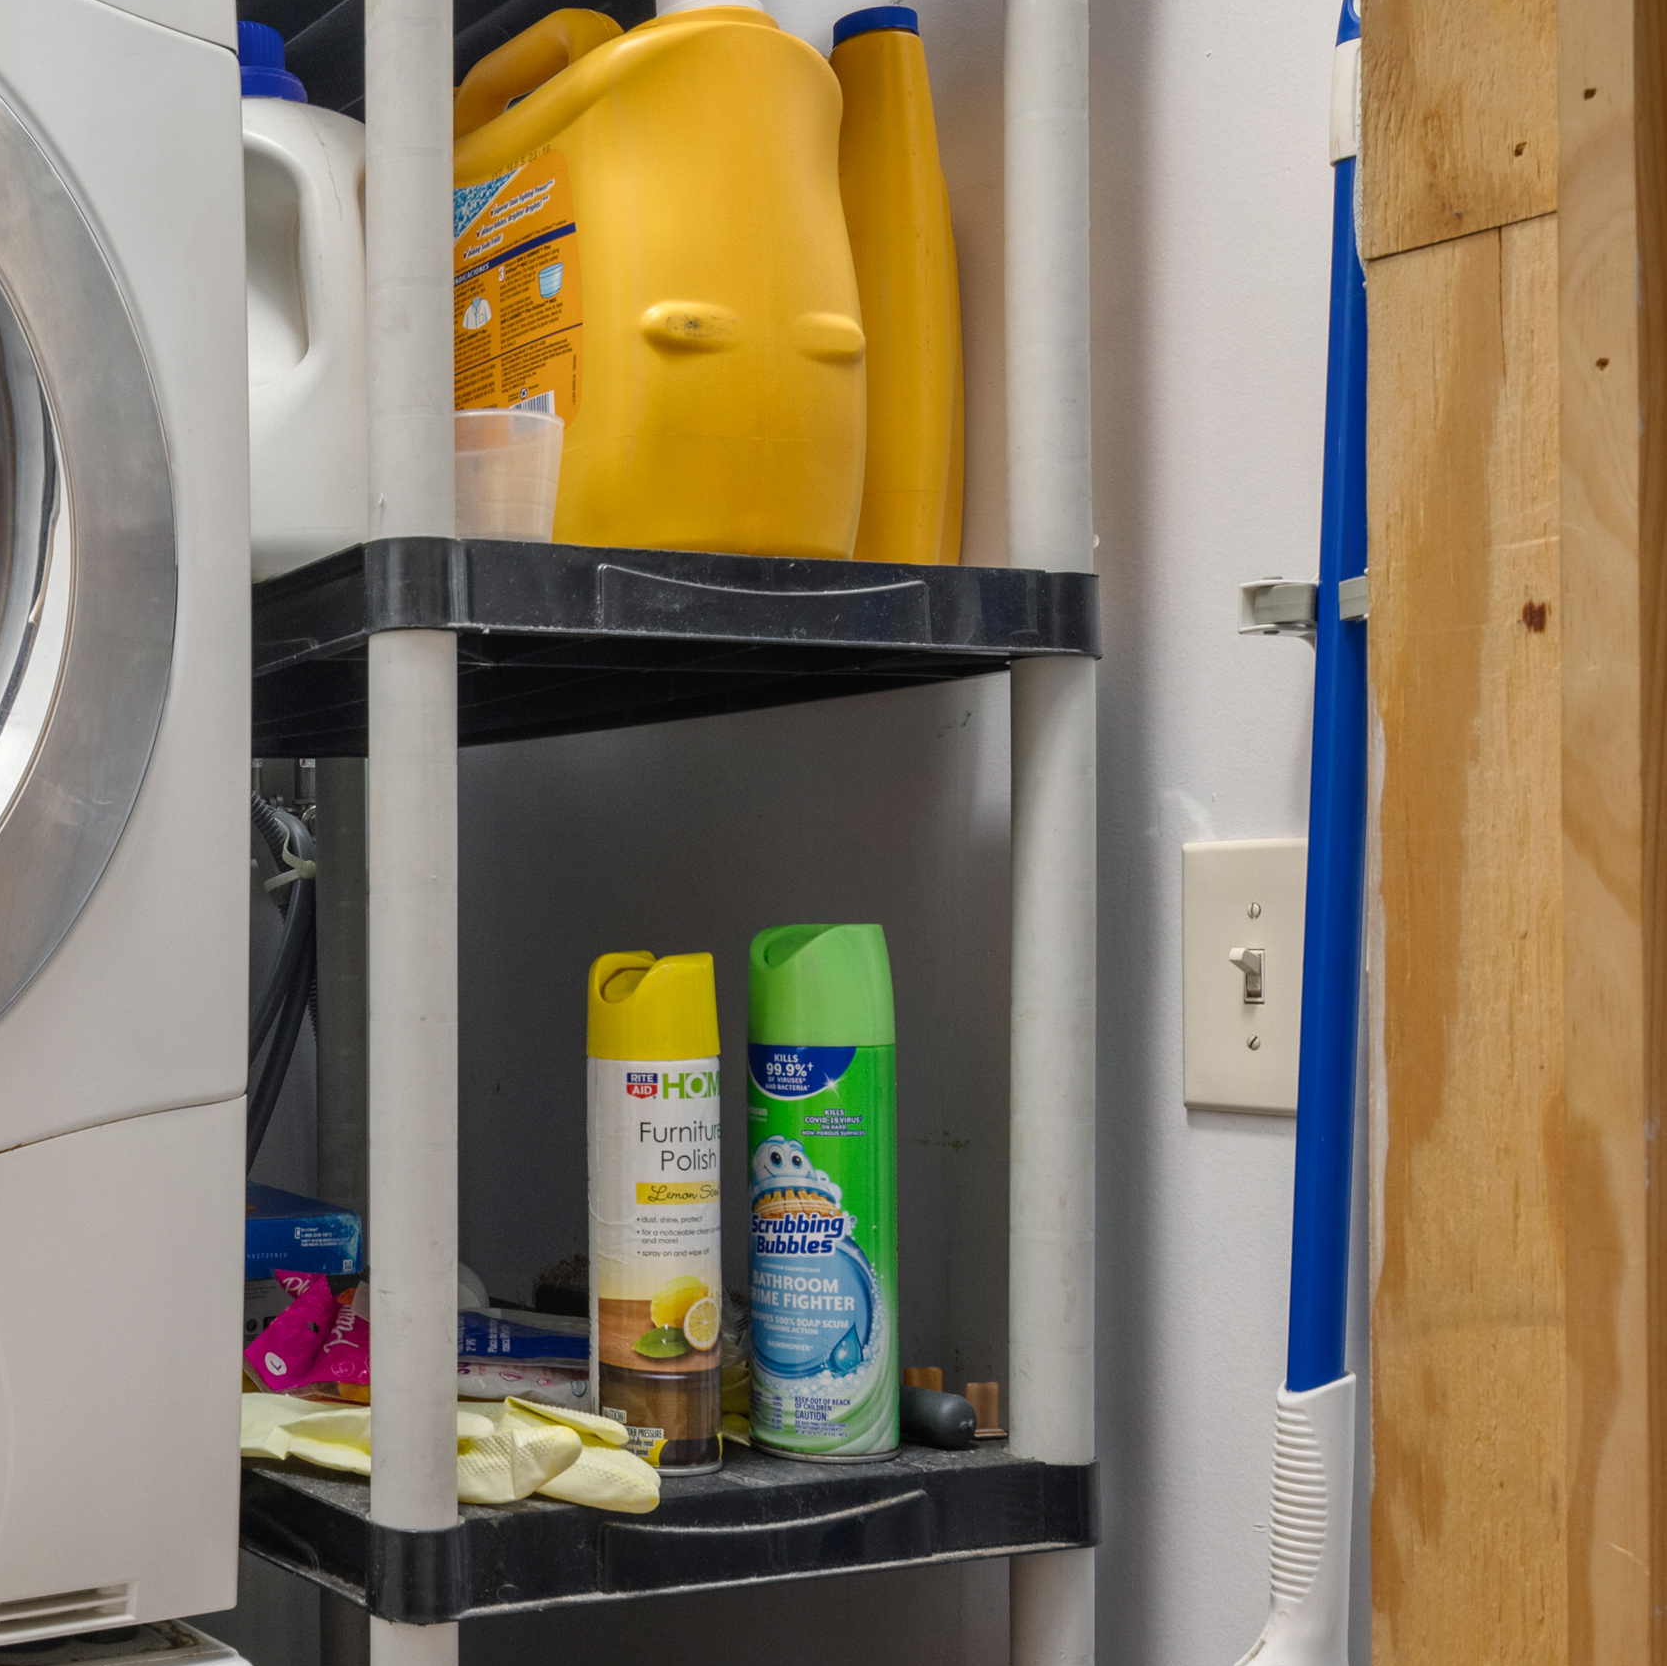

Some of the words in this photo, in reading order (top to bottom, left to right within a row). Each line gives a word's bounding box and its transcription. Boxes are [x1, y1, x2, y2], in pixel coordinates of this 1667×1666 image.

[774, 1054, 799, 1063] KILLS
[630, 1073, 654, 1083] RITE
[632, 1085, 653, 1095] AID
[661, 1148, 717, 1171] Polish
[648, 1184, 698, 1202] Lemon
[641, 1215, 658, 1224] dust,
[660, 1216, 680, 1225] shine,
[680, 1215, 703, 1224] protect
[752, 1213, 845, 1238] Scrubbing
[659, 1228, 695, 1236] noticeable
[756, 1235, 833, 1254] Bubbles
[642, 1250, 661, 1258] spray
[753, 1270, 839, 1293] BATHROOM
[783, 1293, 855, 1311] FIGHTER
[775, 1315, 795, 1325] 100%
[796, 1317, 821, 1327] SOAP
[822, 1320, 849, 1329] SCUM
[764, 1323, 791, 1333] FOAMING
[792, 1326, 819, 1335] ACTION
[810, 1397, 823, 1405] OUT
[803, 1403, 832, 1411] CHILDREN
[795, 1410, 830, 1421] CAUTION:
